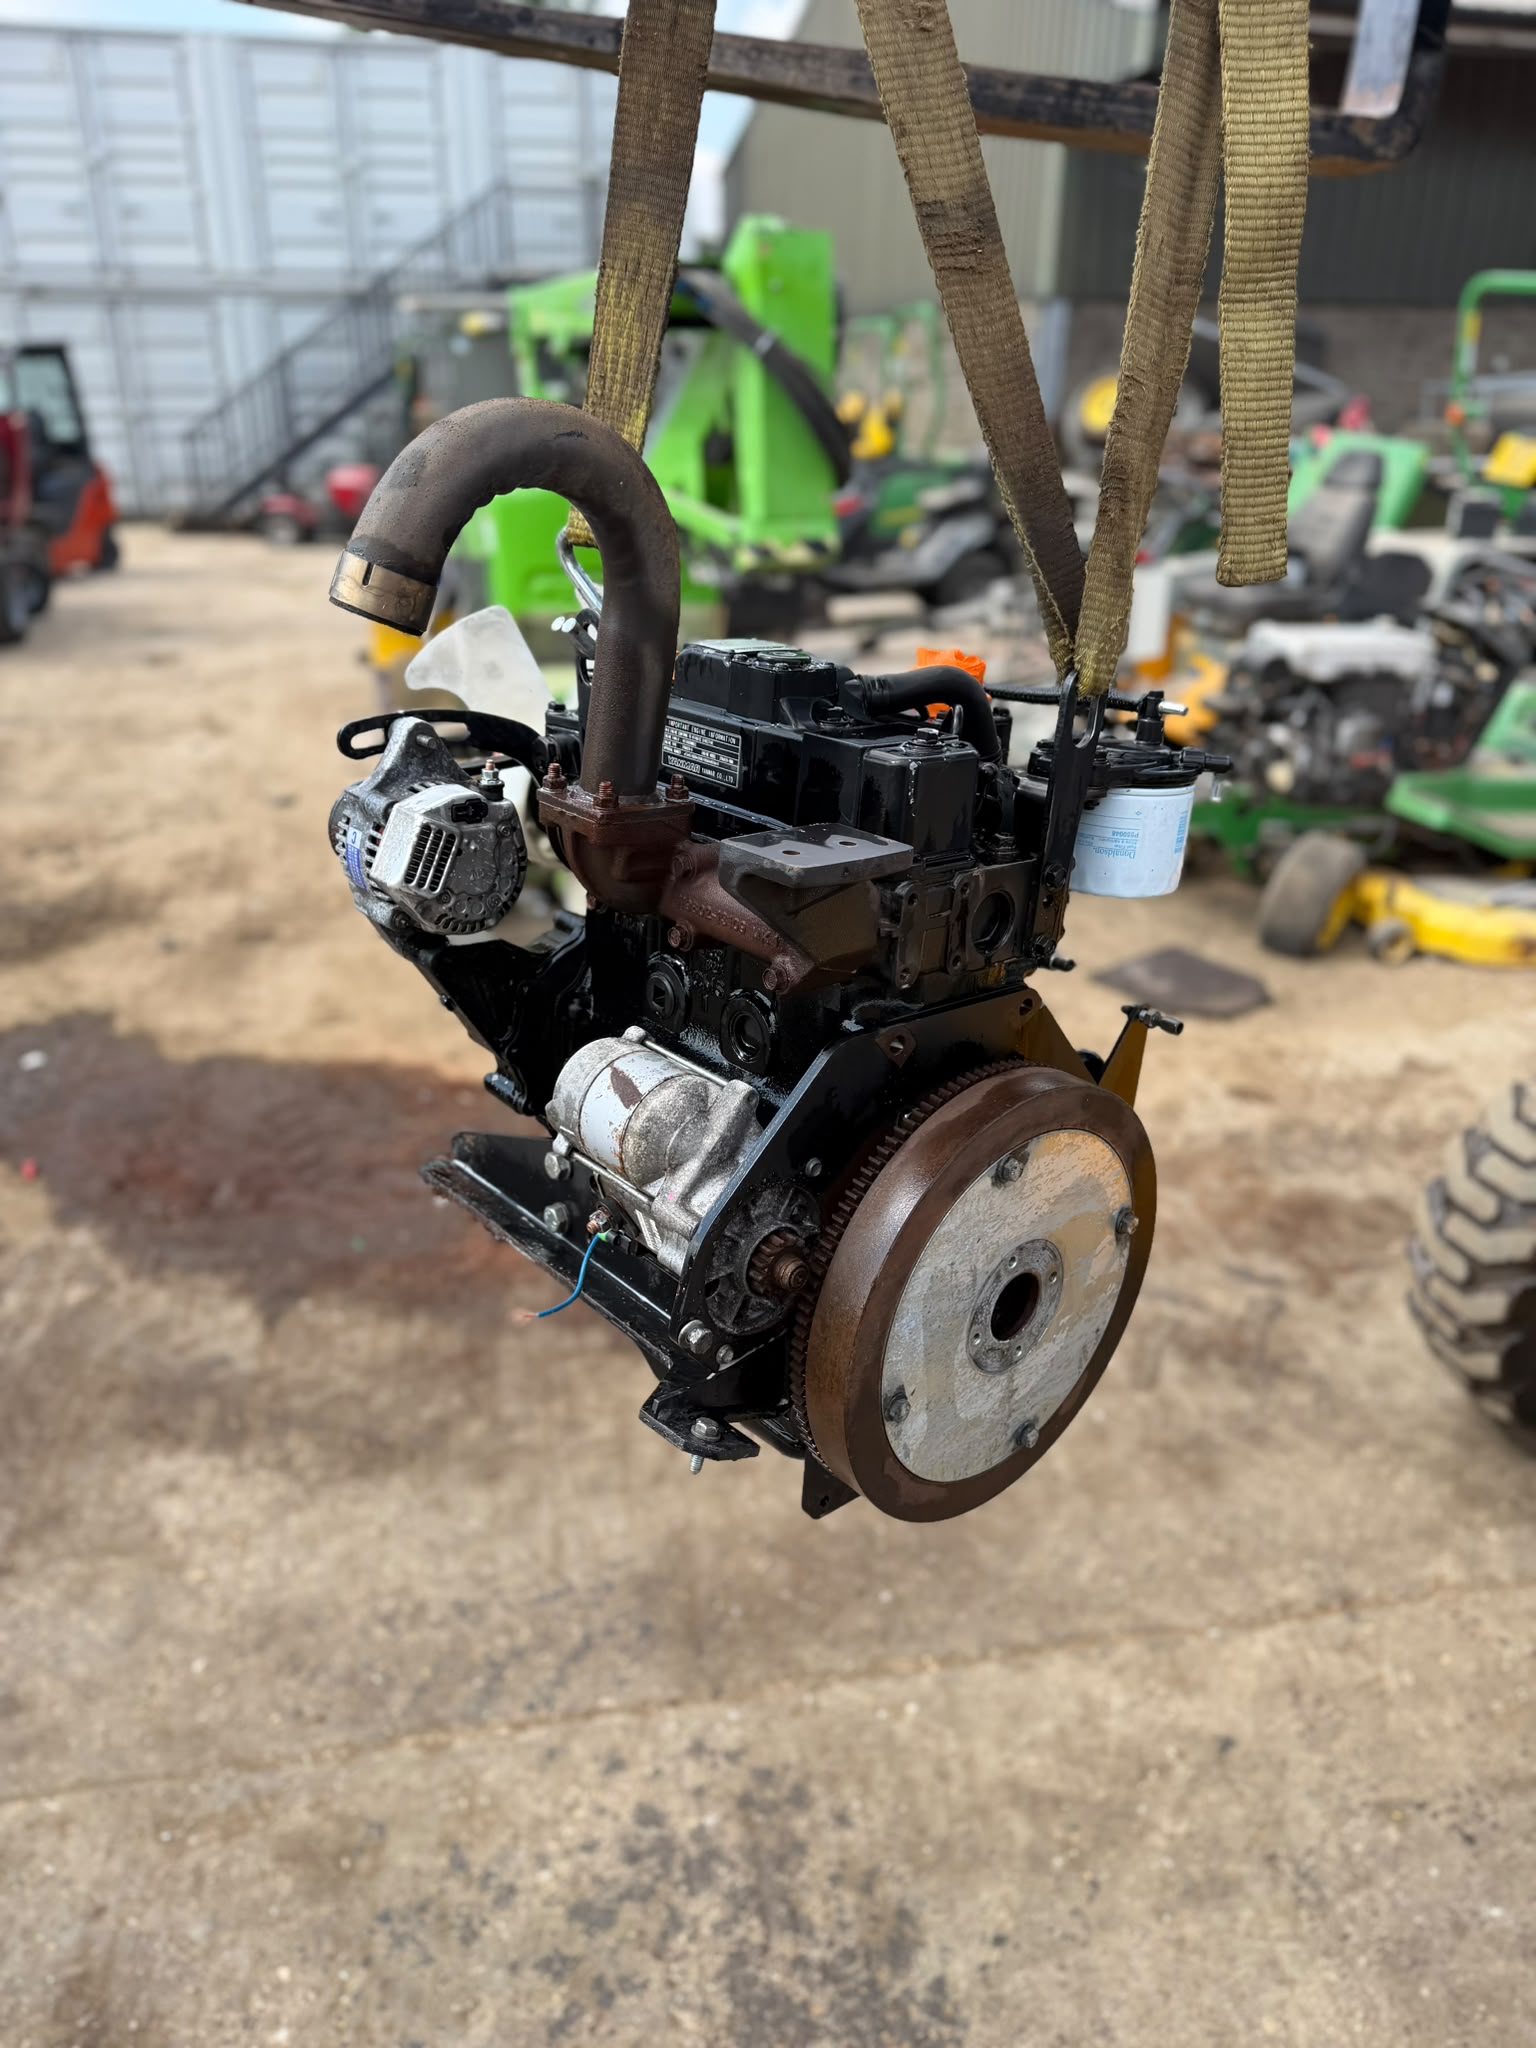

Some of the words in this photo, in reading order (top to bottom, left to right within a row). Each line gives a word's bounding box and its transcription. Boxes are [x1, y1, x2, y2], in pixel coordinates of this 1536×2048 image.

[668, 720, 690, 731] IMPORTANT
[692, 726, 706, 735] ENGINE
[709, 731, 736, 744] INFORMATION
